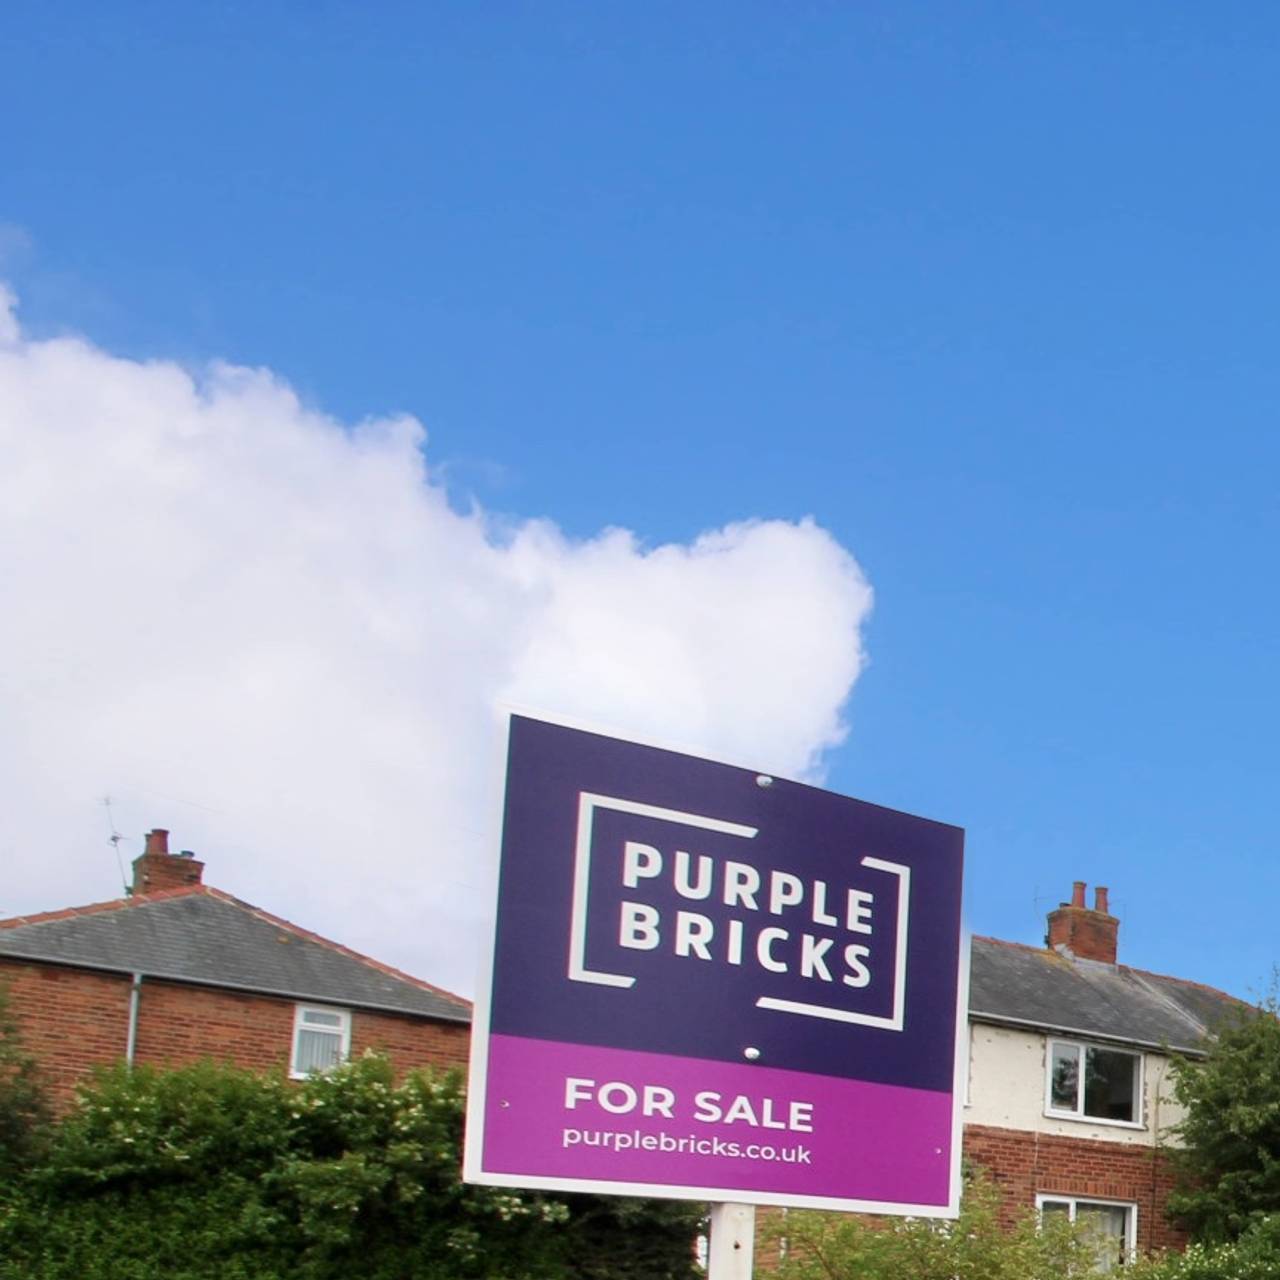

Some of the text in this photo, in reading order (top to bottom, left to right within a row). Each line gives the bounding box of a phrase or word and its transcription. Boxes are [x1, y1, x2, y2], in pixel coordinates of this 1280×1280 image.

[622, 840, 874, 936] PURPLE
[618, 900, 871, 989] BRICKS
[565, 1077, 814, 1133] FOR SALE
[562, 1128, 811, 1165] purplebricks.co.uk
